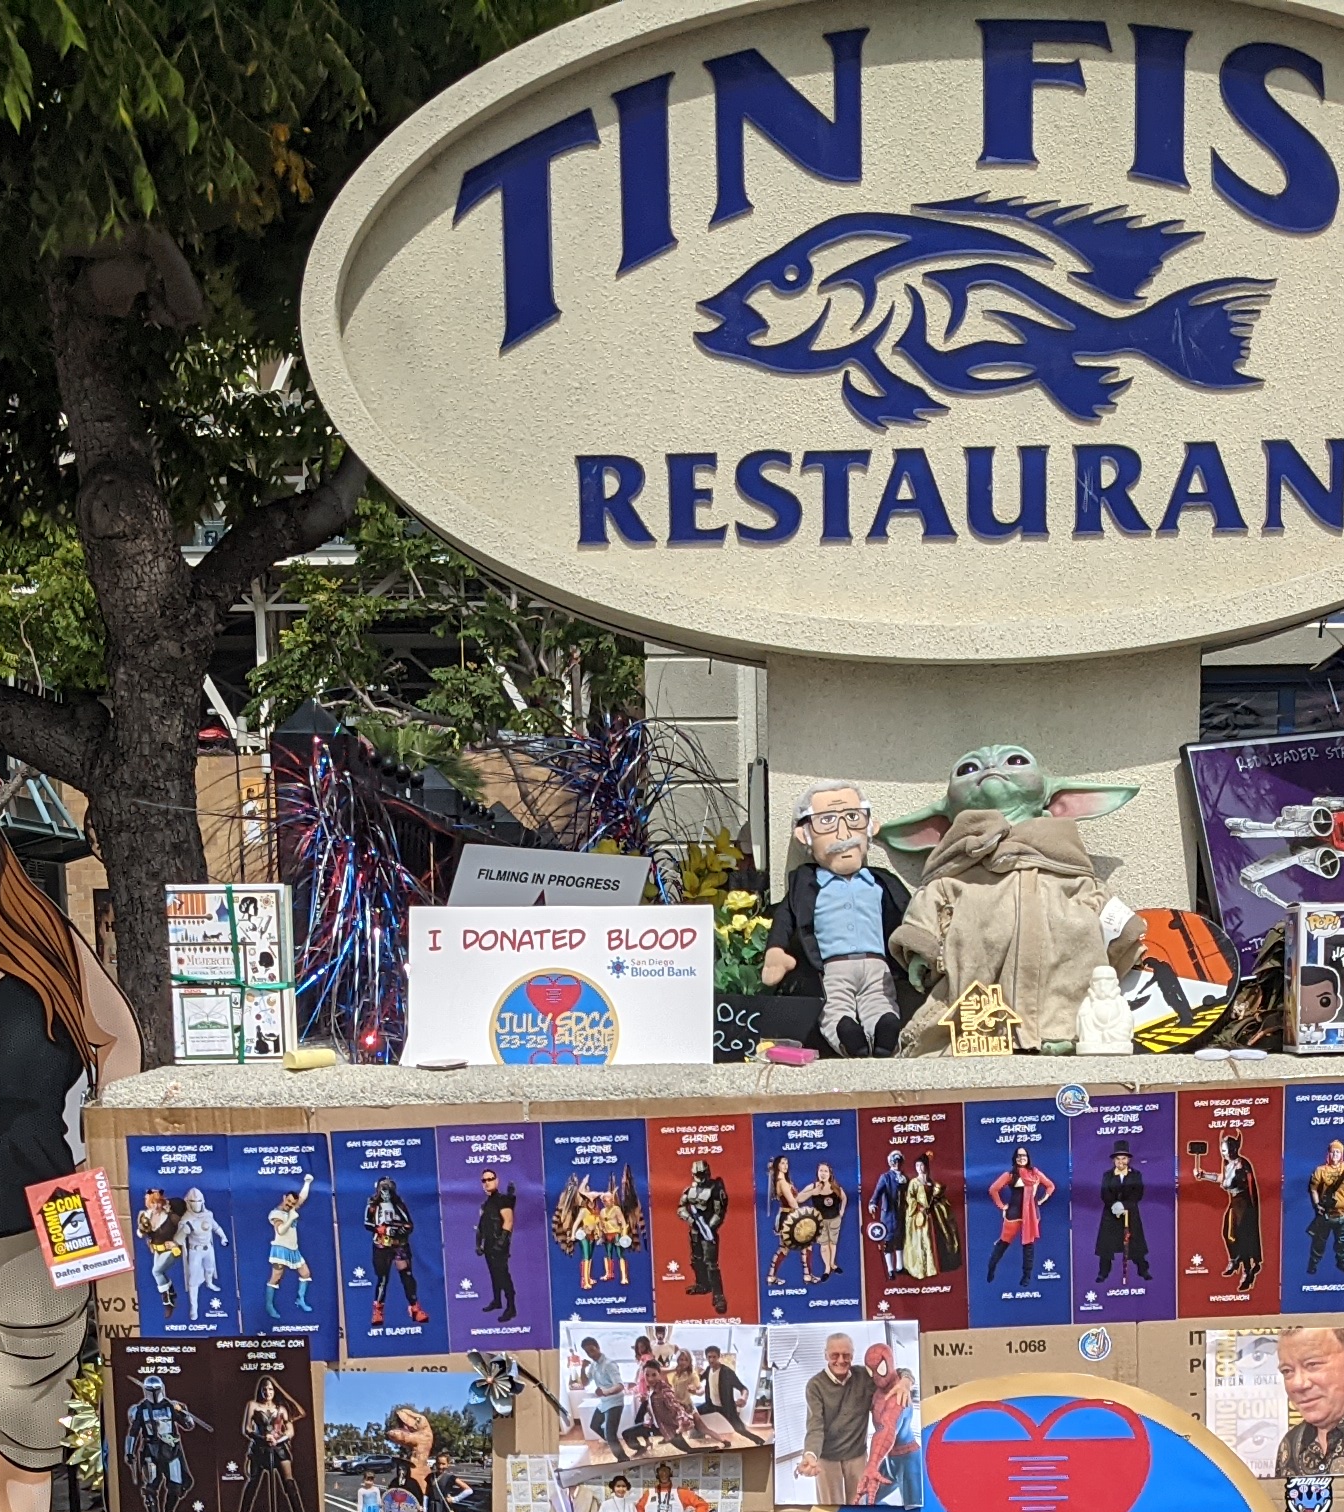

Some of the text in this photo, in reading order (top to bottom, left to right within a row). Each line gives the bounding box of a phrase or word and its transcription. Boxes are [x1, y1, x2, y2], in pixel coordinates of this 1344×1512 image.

[451, 24, 871, 357] TIN
[477, 868, 621, 891] FILMING IN PROGRESS
[1306, 911, 1340, 932] POP!
[428, 928, 697, 952] I DONATED BLOOD
[630, 958, 675, 967] San Diego
[630, 966, 697, 977] Blood Bank
[497, 1011, 615, 1034] JULY SDCC
[499, 1035, 548, 1049] 23-25
[140, 1145, 156, 1153] SAN
[155, 1145, 177, 1153] DIEGO
[198, 1144, 213, 1152] CON
[161, 1153, 198, 1163] SHRINE
[157, 1165, 177, 1175] JULY
[56, 1194, 83, 1213] CON
[95, 1171, 123, 1247] VOLUNTEER
[42, 1201, 65, 1242] COMIC
[82, 1253, 126, 1272] Romanoff
[1015, 1291, 1042, 1299] MARVEL
[368, 1327, 423, 1337] JET BLASTER
[216, 1340, 234, 1349] SAN
[234, 1340, 260, 1348] DIEGO
[287, 1339, 305, 1348] CON
[933, 1340, 1047, 1357] N.W.: 1.068
[247, 1351, 277, 1360] SHRINE
[240, 1362, 259, 1371] JULY
